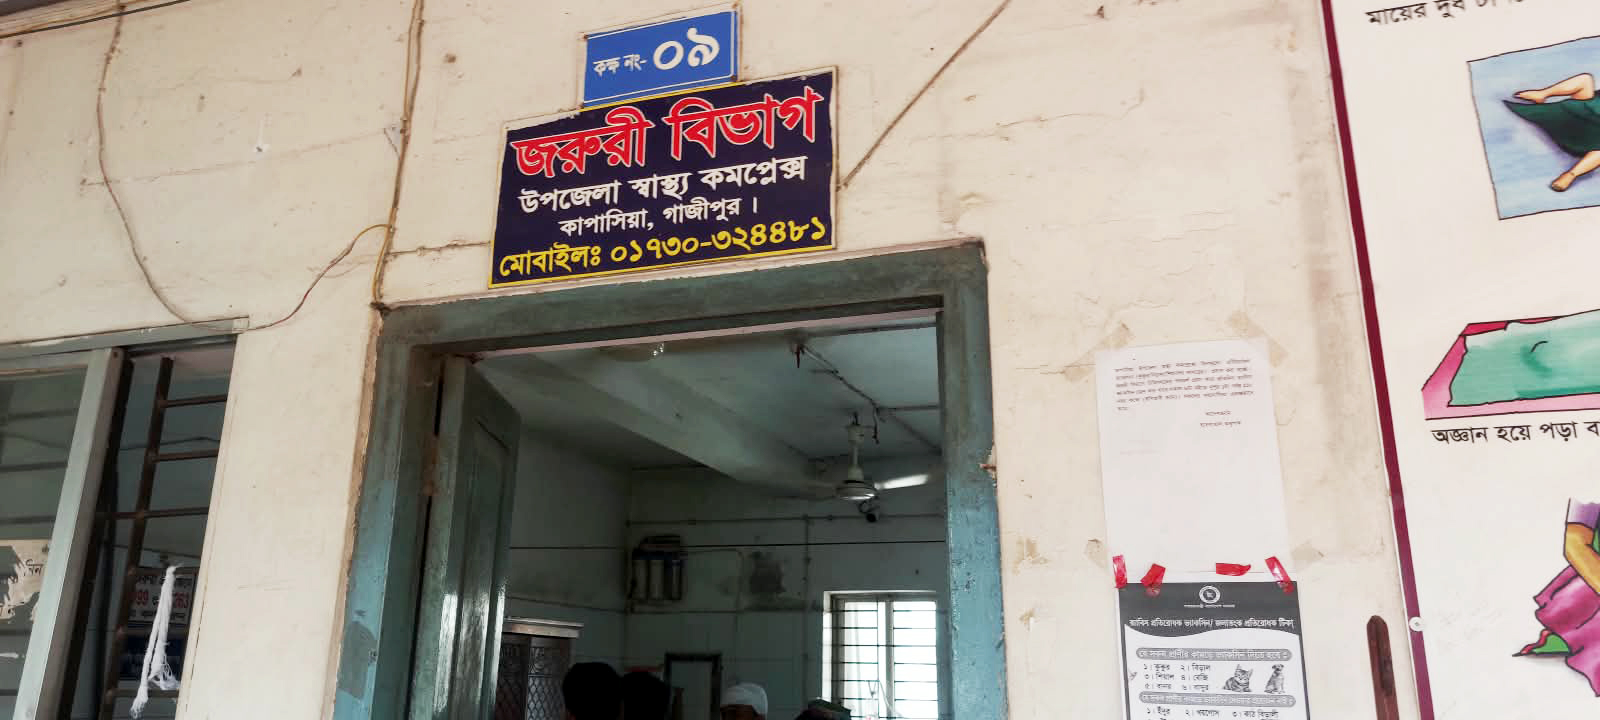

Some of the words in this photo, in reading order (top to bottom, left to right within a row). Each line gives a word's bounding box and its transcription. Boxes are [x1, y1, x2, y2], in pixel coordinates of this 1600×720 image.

[1365, 3, 1427, 25] মায়ের
[593, 56, 620, 77] কক্ষ
[653, 28, 720, 71] ০৯
[511, 106, 653, 178] জরুরী
[662, 86, 825, 161] বিভাগ
[518, 180, 622, 214] উপজেলা
[630, 173, 692, 200] স্বাস্থ্য
[699, 156, 808, 191] কমপ্লেক্স
[558, 209, 654, 237] কাপাসিয়া,
[662, 197, 742, 225] গাজীপুর
[499, 248, 602, 278] মোবাইলঃ
[610, 217, 827, 264] ০১৭৩০-৩২৪৪৮১
[1431, 427, 1489, 444] অজ্ঞান
[1494, 425, 1532, 443] হয়ে
[1539, 421, 1578, 442] পড়া
[1584, 421, 1600, 436] ব
